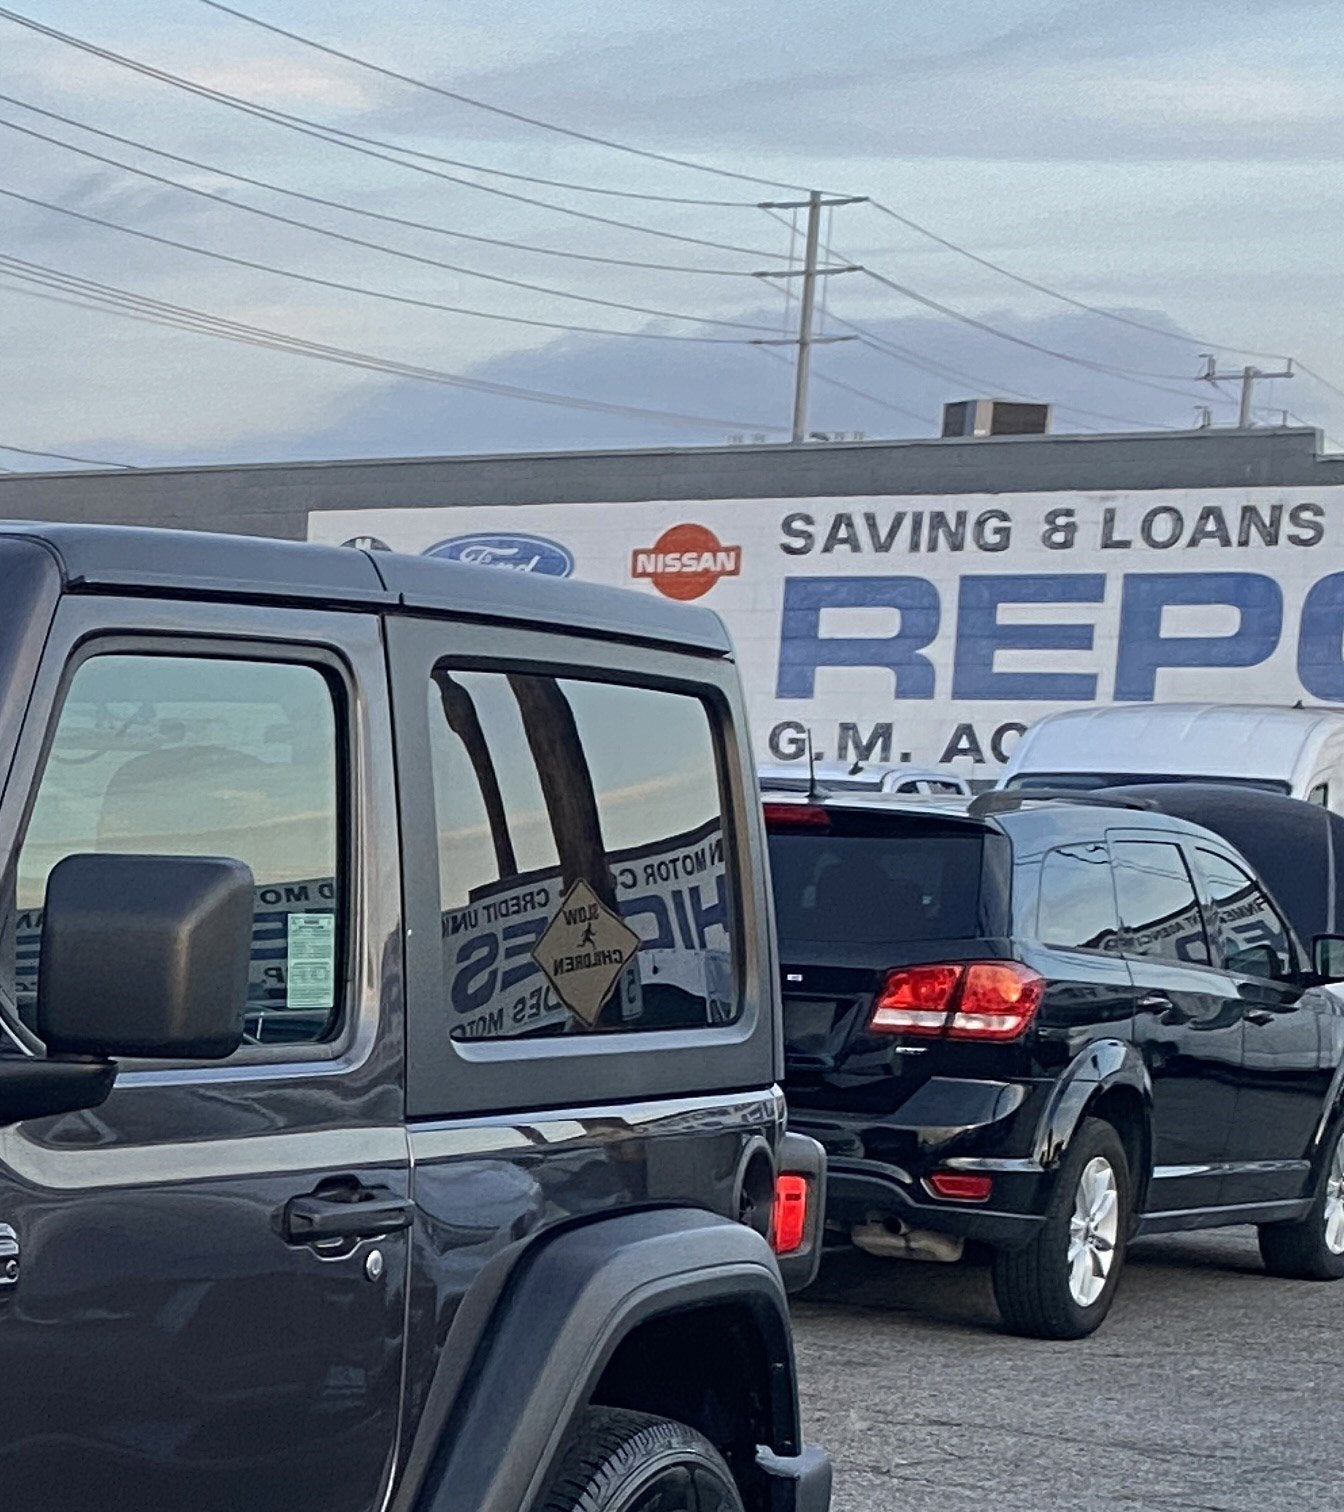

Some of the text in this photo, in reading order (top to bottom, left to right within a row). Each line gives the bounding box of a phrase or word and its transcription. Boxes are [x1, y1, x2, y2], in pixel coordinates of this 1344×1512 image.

[779, 502, 1326, 556] SAVING & LOANS
[636, 550, 738, 574] NISSAN
[775, 572, 1344, 702] REP
[768, 721, 912, 764] G.M.
